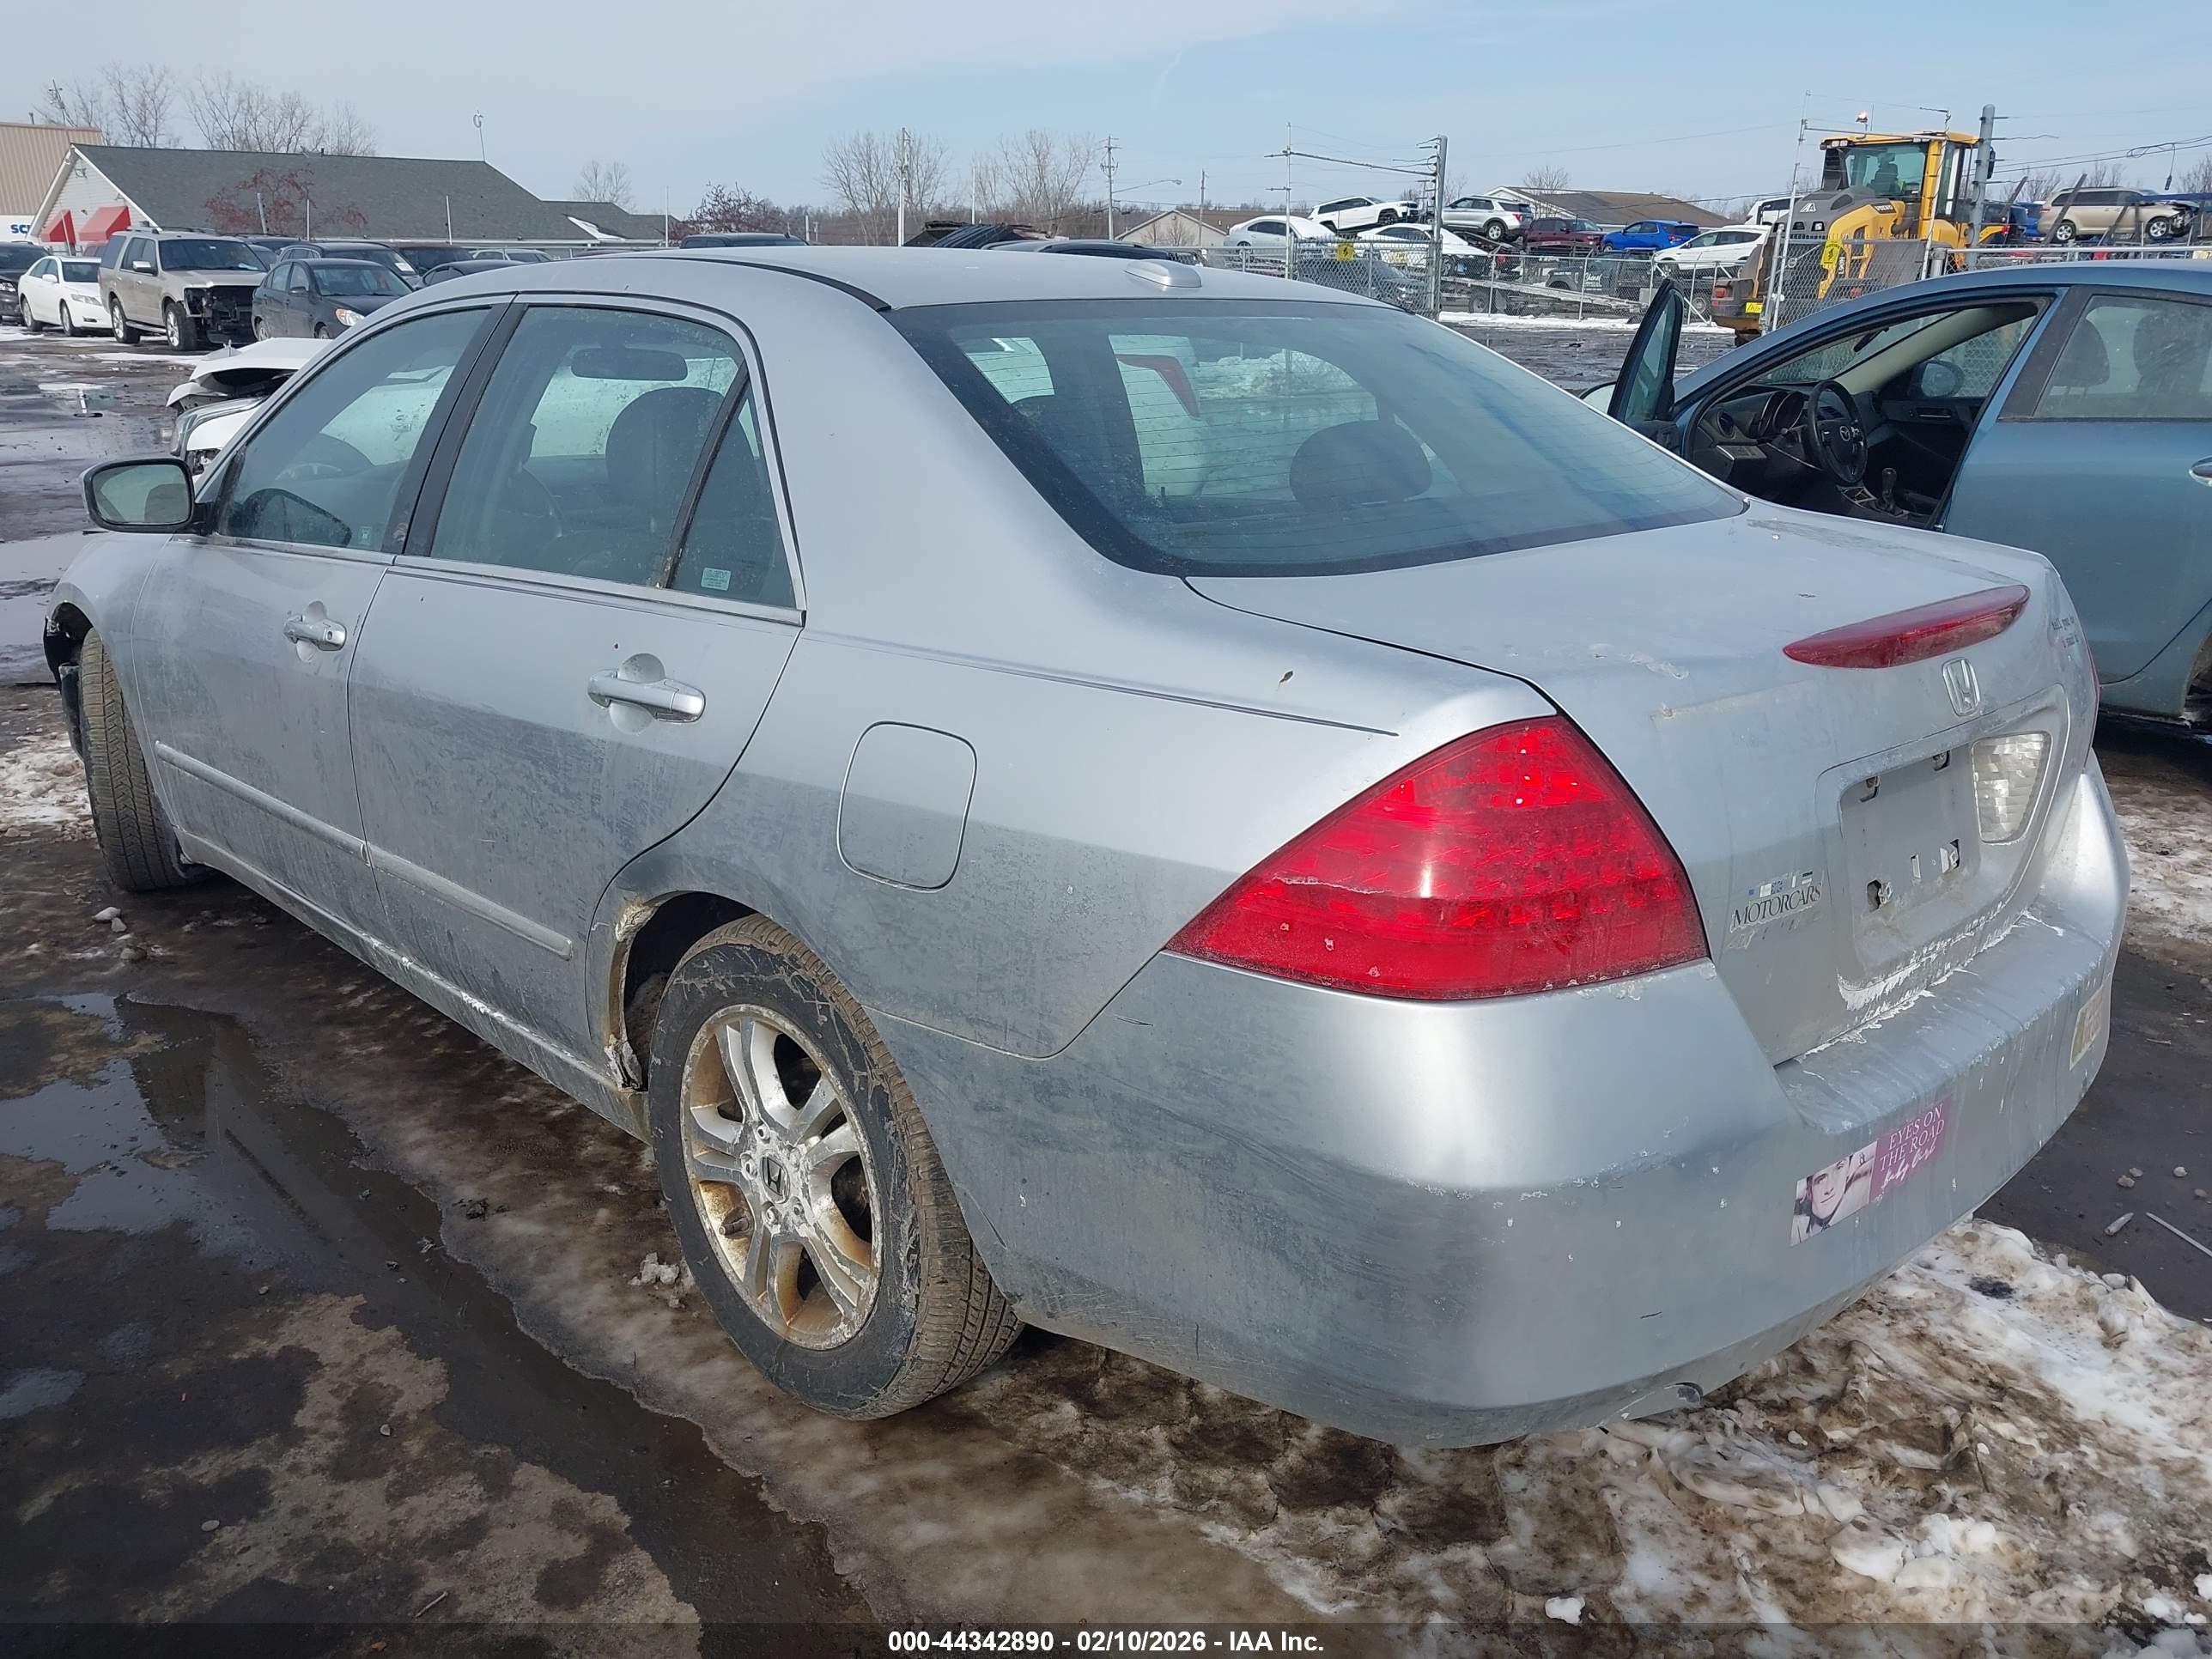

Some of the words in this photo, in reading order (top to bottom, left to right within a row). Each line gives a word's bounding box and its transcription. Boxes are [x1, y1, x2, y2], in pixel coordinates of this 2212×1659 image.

[1733, 884, 1820, 927] MOTORCARS
[1880, 1143, 1907, 1171] THE
[1910, 1119, 1944, 1152] ROAD
[1889, 1119, 1920, 1150] EYES
[1923, 1103, 1942, 1127] ON
